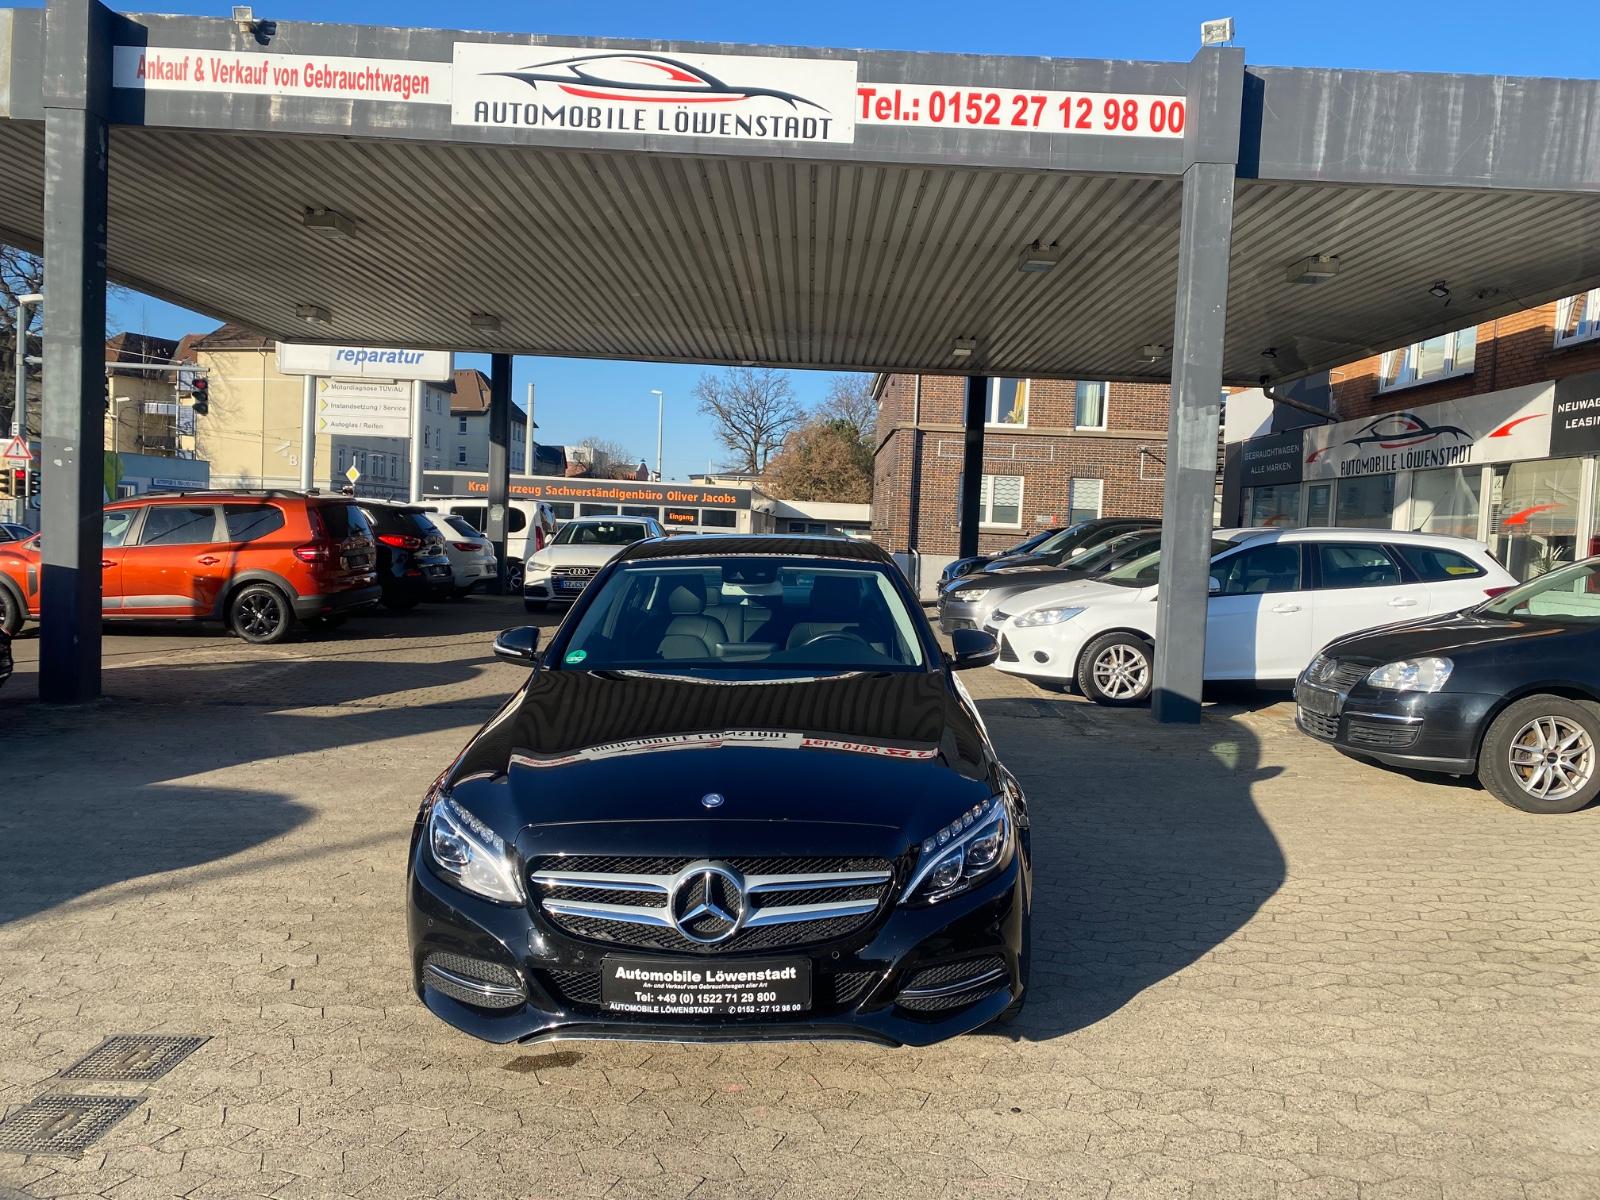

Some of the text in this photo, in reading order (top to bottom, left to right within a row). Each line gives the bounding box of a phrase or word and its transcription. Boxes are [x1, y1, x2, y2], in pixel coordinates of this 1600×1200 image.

[136, 54, 430, 100] Ankauf & Verkauf von Gebrauchtwagen
[857, 87, 1186, 133] Tel.: 0152 27 12 98 00
[473, 100, 833, 141] AUTOMOBILE LÖWENSTADT
[336, 348, 425, 366] reparatur
[330, 383, 378, 393] Motordiagnose
[330, 402, 379, 412] Instandsetzung
[382, 404, 407, 412] Service
[330, 421, 359, 430] Autoglas
[363, 421, 384, 430] Reifen
[1244, 444, 1300, 461] GEBRAUCHTWAGEN
[1340, 443, 1474, 476] AUTOMOBILE LÖWENSTADT
[1250, 461, 1292, 474] ALLE MARKEN
[545, 485, 663, 501] Sachverständigenbüro
[666, 490, 698, 503] Oliver
[701, 492, 737, 504] Jacobs
[669, 512, 694, 522] Eingang
[615, 966, 797, 983] Automobile Löwenstadt
[634, 991, 777, 1005] Tel: +49 (0) 1522 71 29 800
[609, 1002, 660, 1013] AUTOMOBILE
[660, 1005, 714, 1014] LÖWENSTADT
[737, 1005, 755, 1013] 0152
[760, 1005, 770, 1013] 27
[771, 1004, 780, 1013] 12
[781, 1004, 791, 1012] 98
[791, 1003, 801, 1012] 00
